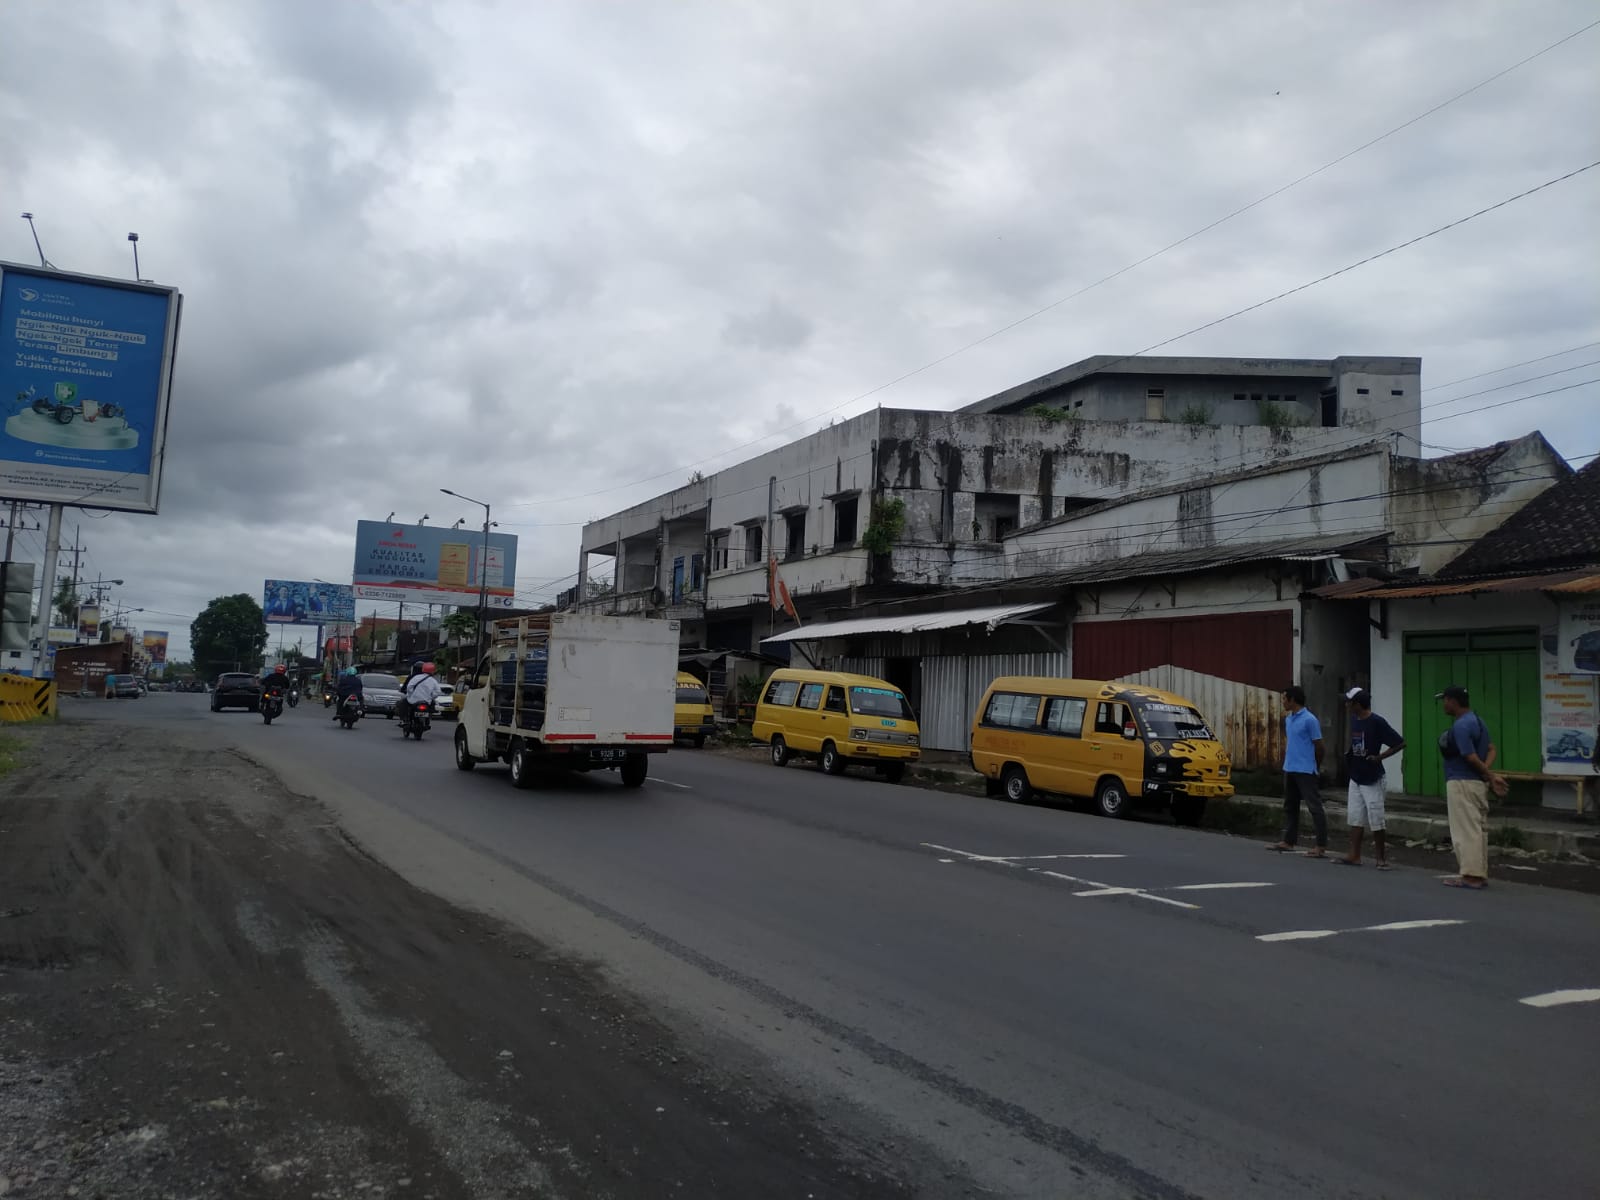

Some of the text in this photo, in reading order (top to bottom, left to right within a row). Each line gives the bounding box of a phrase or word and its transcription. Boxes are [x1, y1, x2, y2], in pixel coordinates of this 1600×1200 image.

[20, 309, 104, 327] Mobilmu bunyi
[18, 319, 144, 343] Ngik-Ngik Nguk-Nguk
[18, 339, 56, 351] Terasa
[58, 344, 108, 358] Limbung
[88, 339, 119, 350] Terus
[51, 357, 87, 368] Servis
[369, 554, 426, 564] UNGGULAN
[372, 549, 424, 558] KUALITAS
[368, 567, 425, 578] EKONOMIS
[379, 563, 415, 572] HARGA
